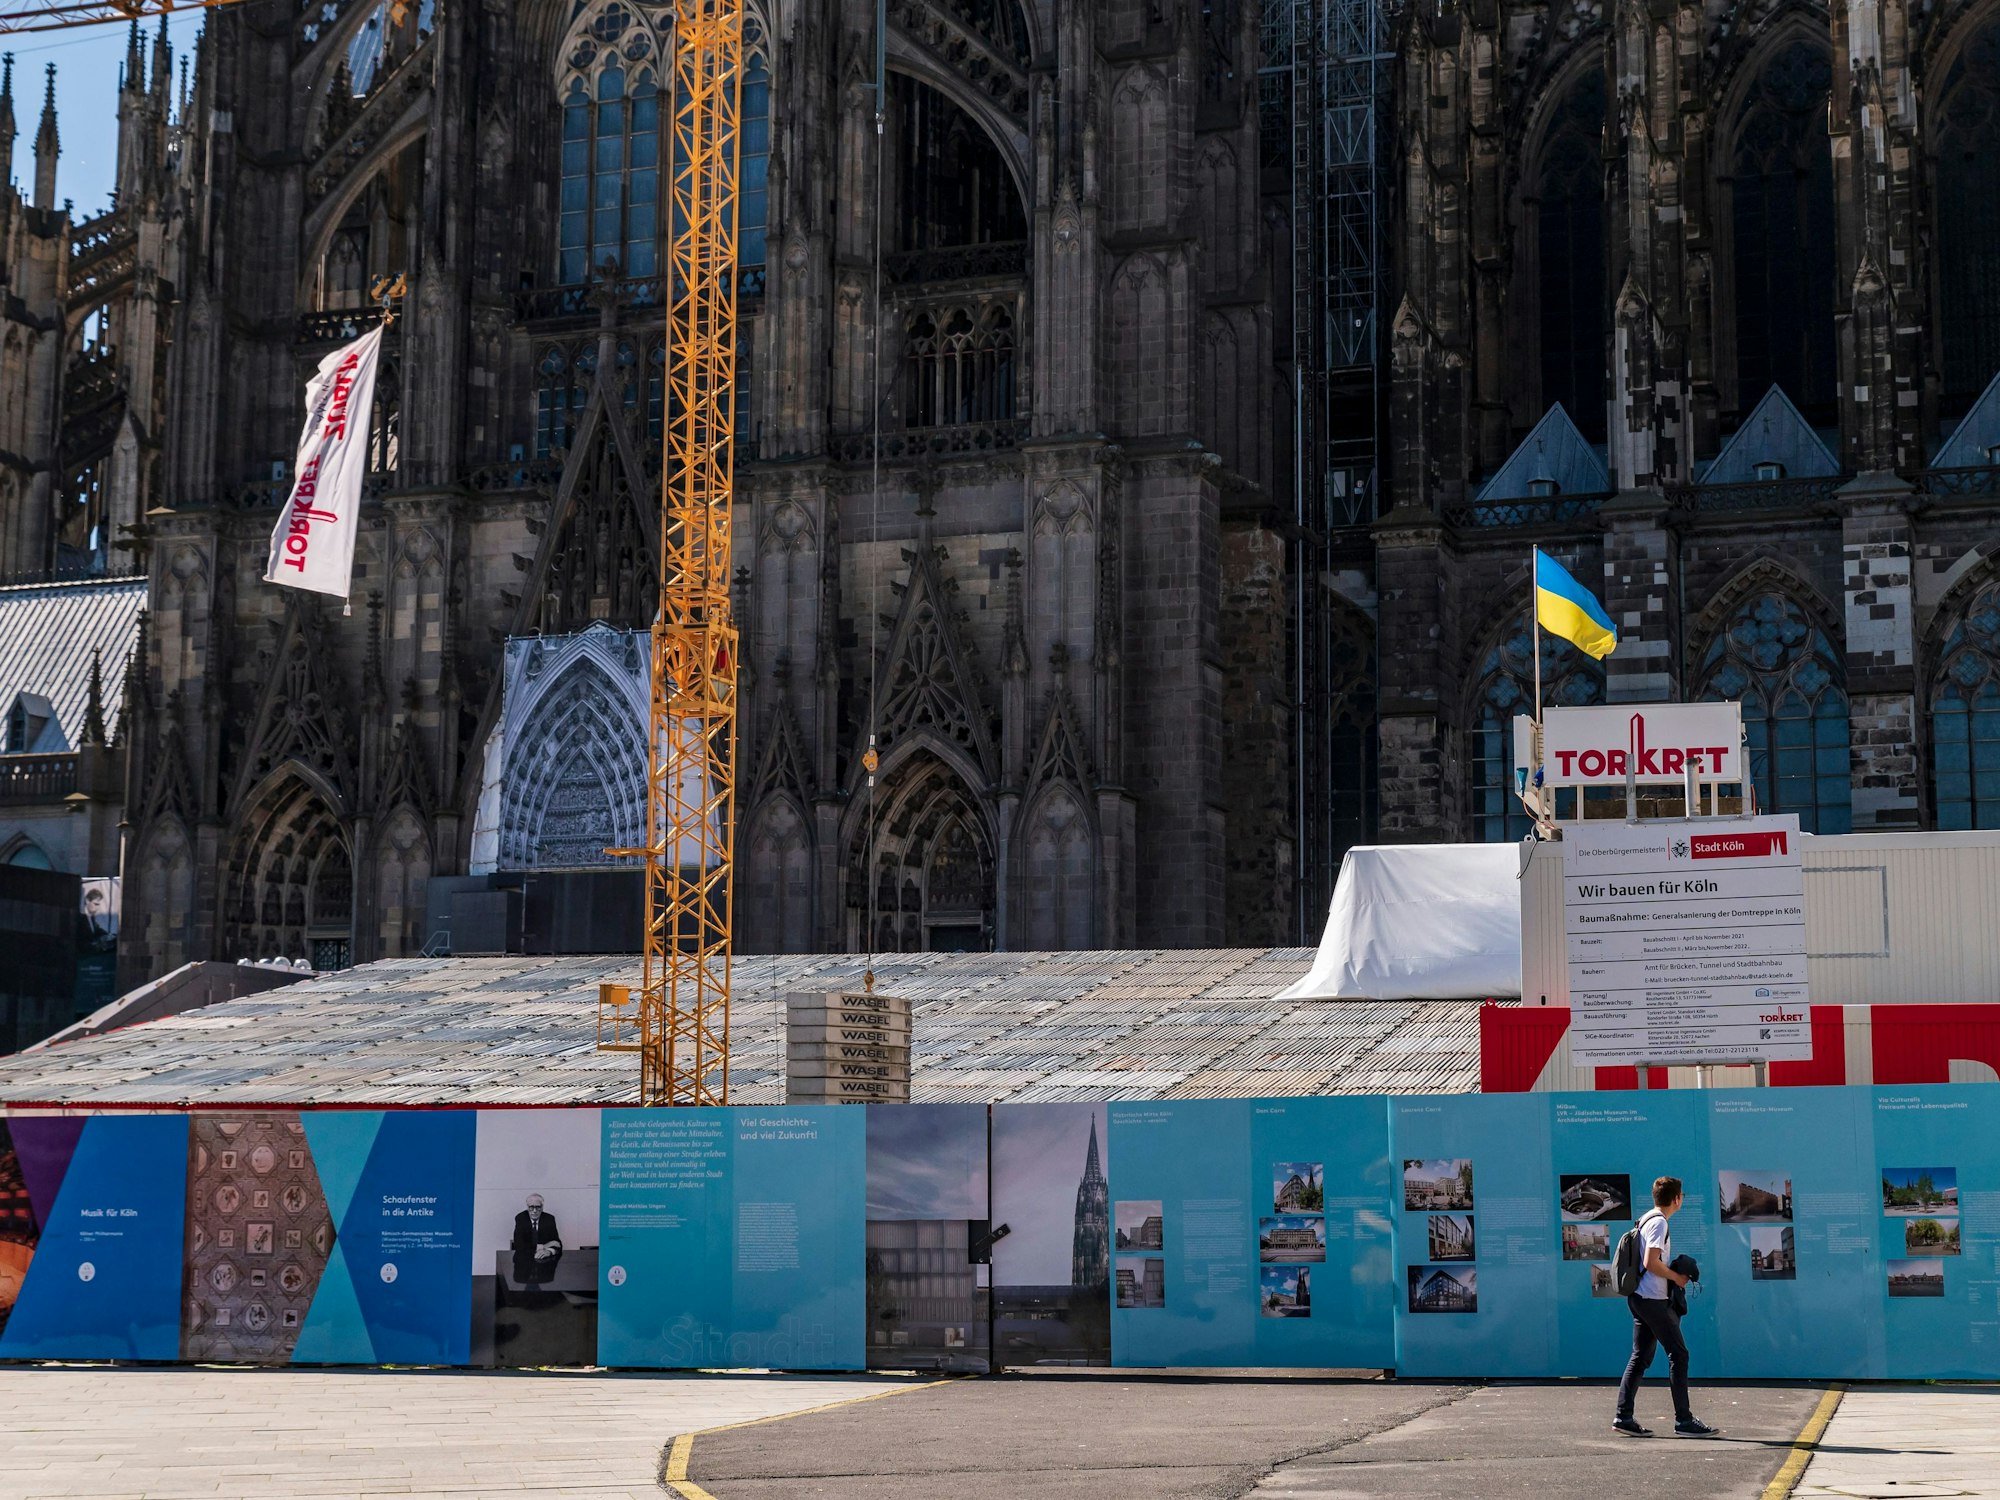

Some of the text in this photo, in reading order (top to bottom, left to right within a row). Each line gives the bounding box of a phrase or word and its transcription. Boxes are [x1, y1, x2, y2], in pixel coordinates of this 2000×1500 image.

[1578, 846, 1666, 857] Die Oberbürgermeisterin
[1695, 841, 1745, 852] Stadt Köln
[1578, 879, 1718, 898] Wir bauen für Köln
[1579, 913, 1650, 923] Baumaßnahme:
[1652, 910, 1716, 920] Generalsanierung
[1717, 910, 1730, 918] der
[1731, 909, 1774, 918] Domtreppe
[841, 997, 890, 1009] WASEL
[1583, 999, 1634, 1007] Bauüberwachung:
[841, 1013, 890, 1025] WASEL
[1758, 1013, 1804, 1023] TORKRET
[841, 1031, 889, 1042] WASEL
[841, 1048, 889, 1059] WASEL
[841, 1065, 890, 1076] WASEL
[841, 1082, 889, 1093] WASEL
[740, 1118, 757, 1127] Viel
[759, 1117, 809, 1127] Geschichte
[740, 1130, 818, 1140] und viel Zukunft!
[382, 1195, 438, 1204] Schaufenster
[80, 1208, 138, 1217] Musik für Köln
[382, 1207, 434, 1216] in die Antike
